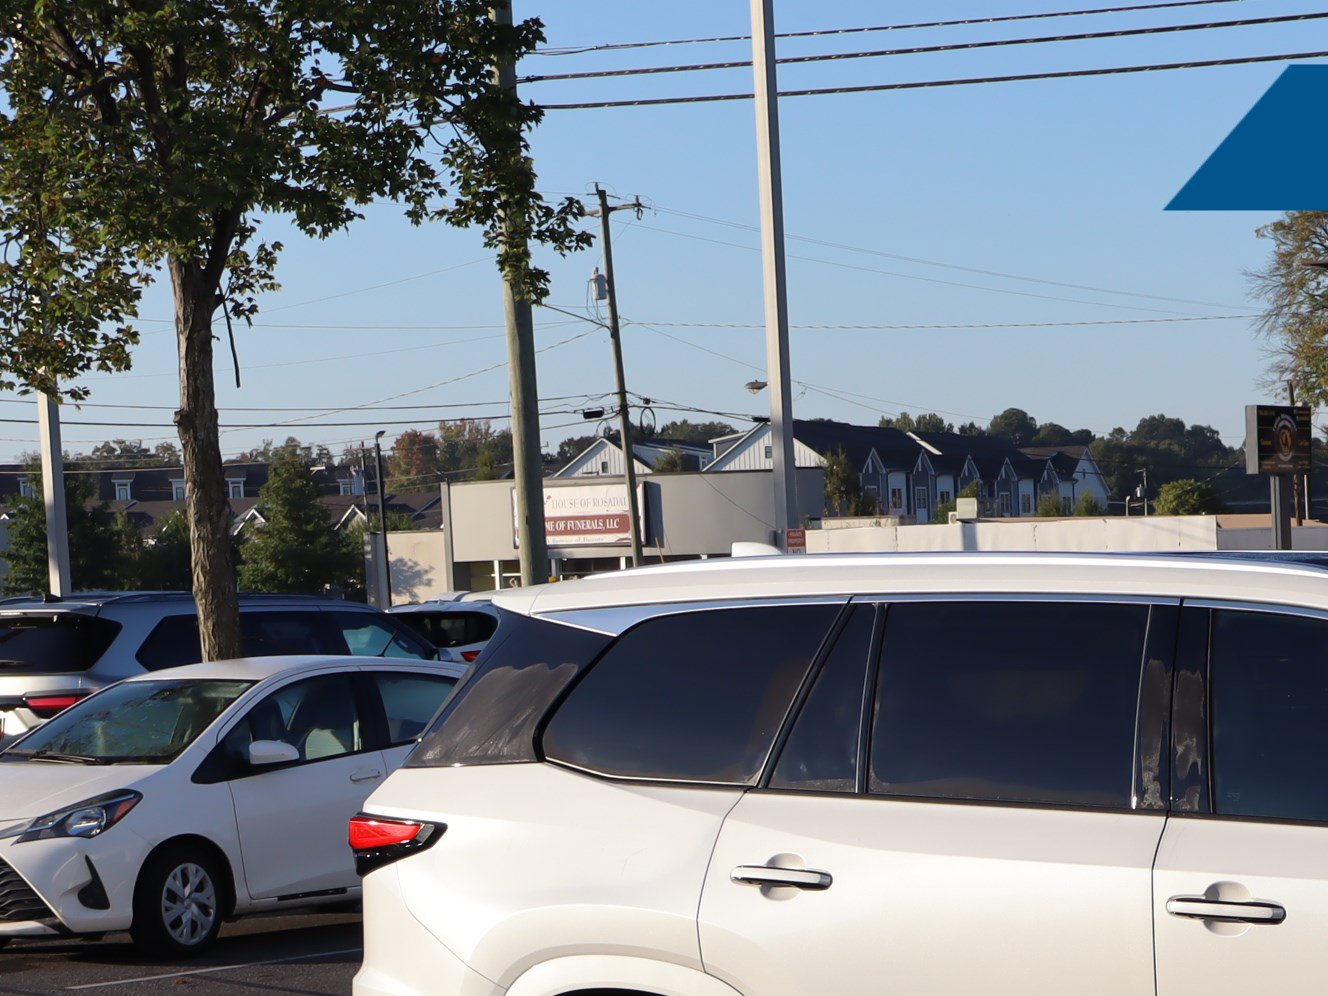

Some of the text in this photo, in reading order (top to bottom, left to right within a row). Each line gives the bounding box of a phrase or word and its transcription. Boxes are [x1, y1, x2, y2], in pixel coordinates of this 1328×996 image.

[552, 496, 627, 510] HOUSE OF ROSADAL
[545, 521, 555, 532] ME
[556, 521, 566, 531] OF
[606, 518, 620, 529] LLC
